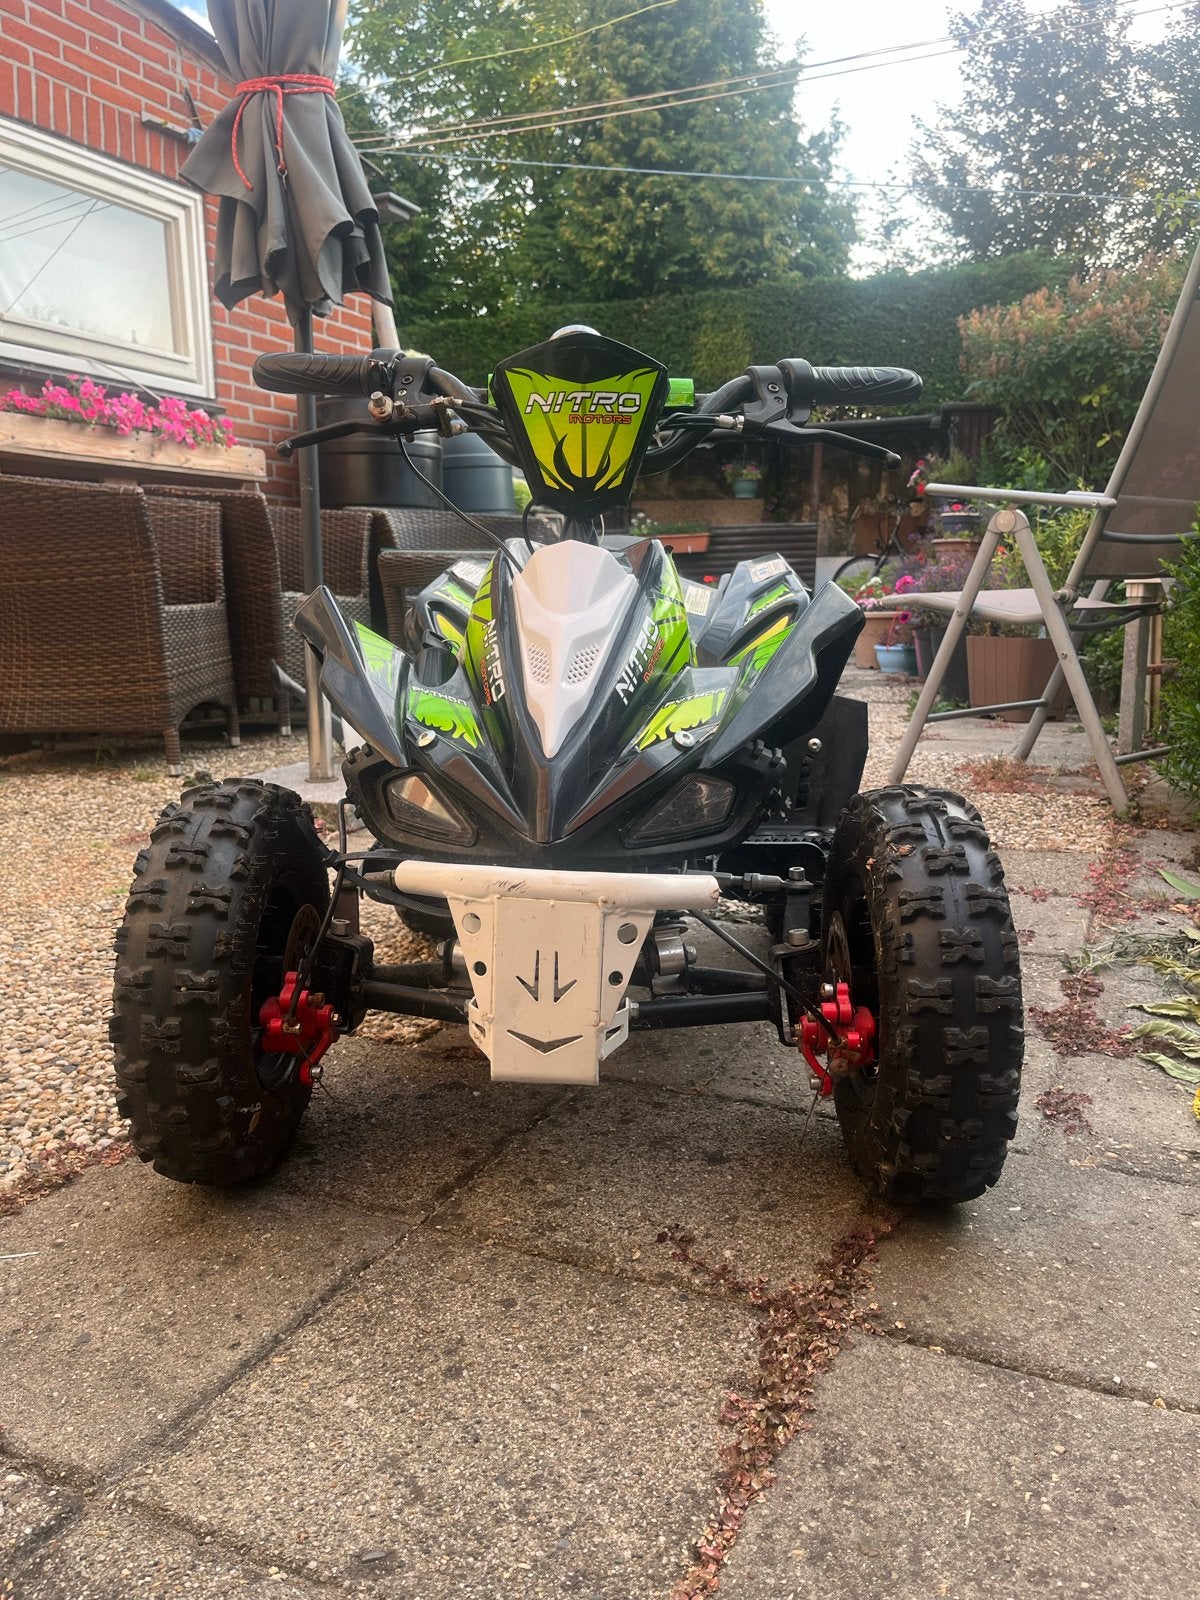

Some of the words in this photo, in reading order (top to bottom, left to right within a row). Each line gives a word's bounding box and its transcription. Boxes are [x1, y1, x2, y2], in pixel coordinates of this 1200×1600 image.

[524, 391, 641, 414] NITRO
[569, 415, 632, 424] MOTORS
[482, 618, 506, 702] NITRO
[615, 616, 660, 706] NITRO
[411, 686, 467, 706] PYTHON
